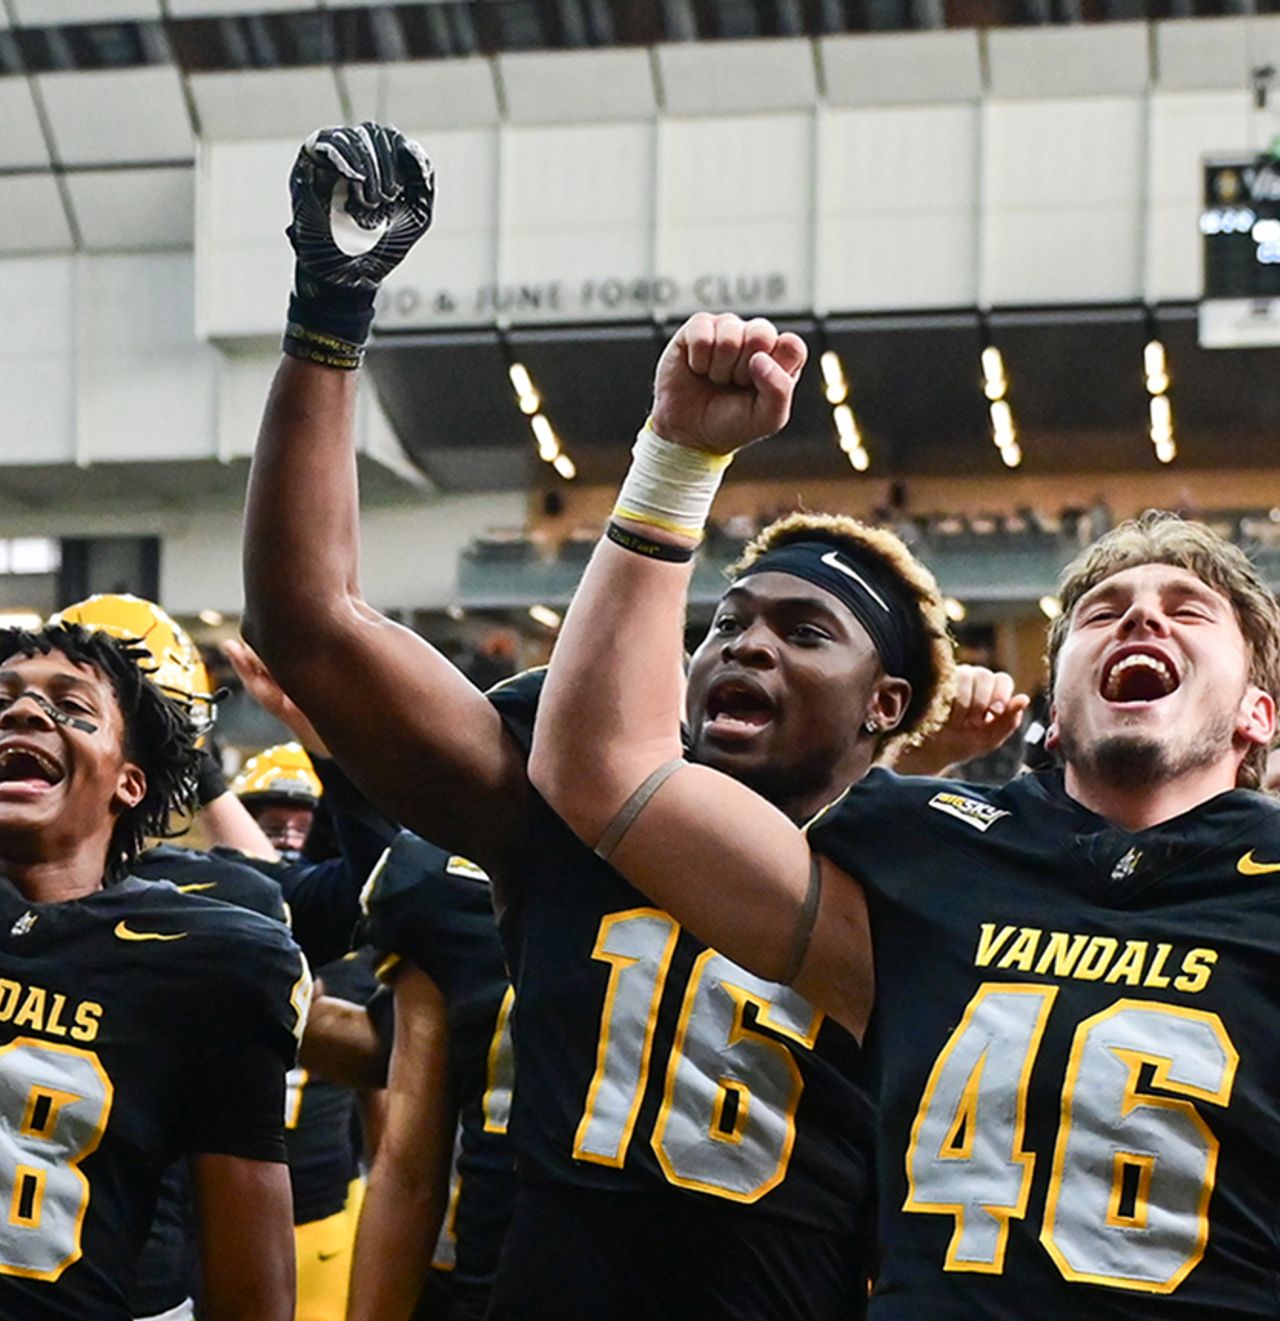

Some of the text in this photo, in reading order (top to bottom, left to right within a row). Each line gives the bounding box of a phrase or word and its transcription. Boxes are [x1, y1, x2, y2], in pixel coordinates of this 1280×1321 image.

[692, 270, 788, 306] CLUB
[973, 921, 1218, 995] VANDALS
[572, 906, 827, 1206] 16
[901, 982, 1239, 1296] 46
